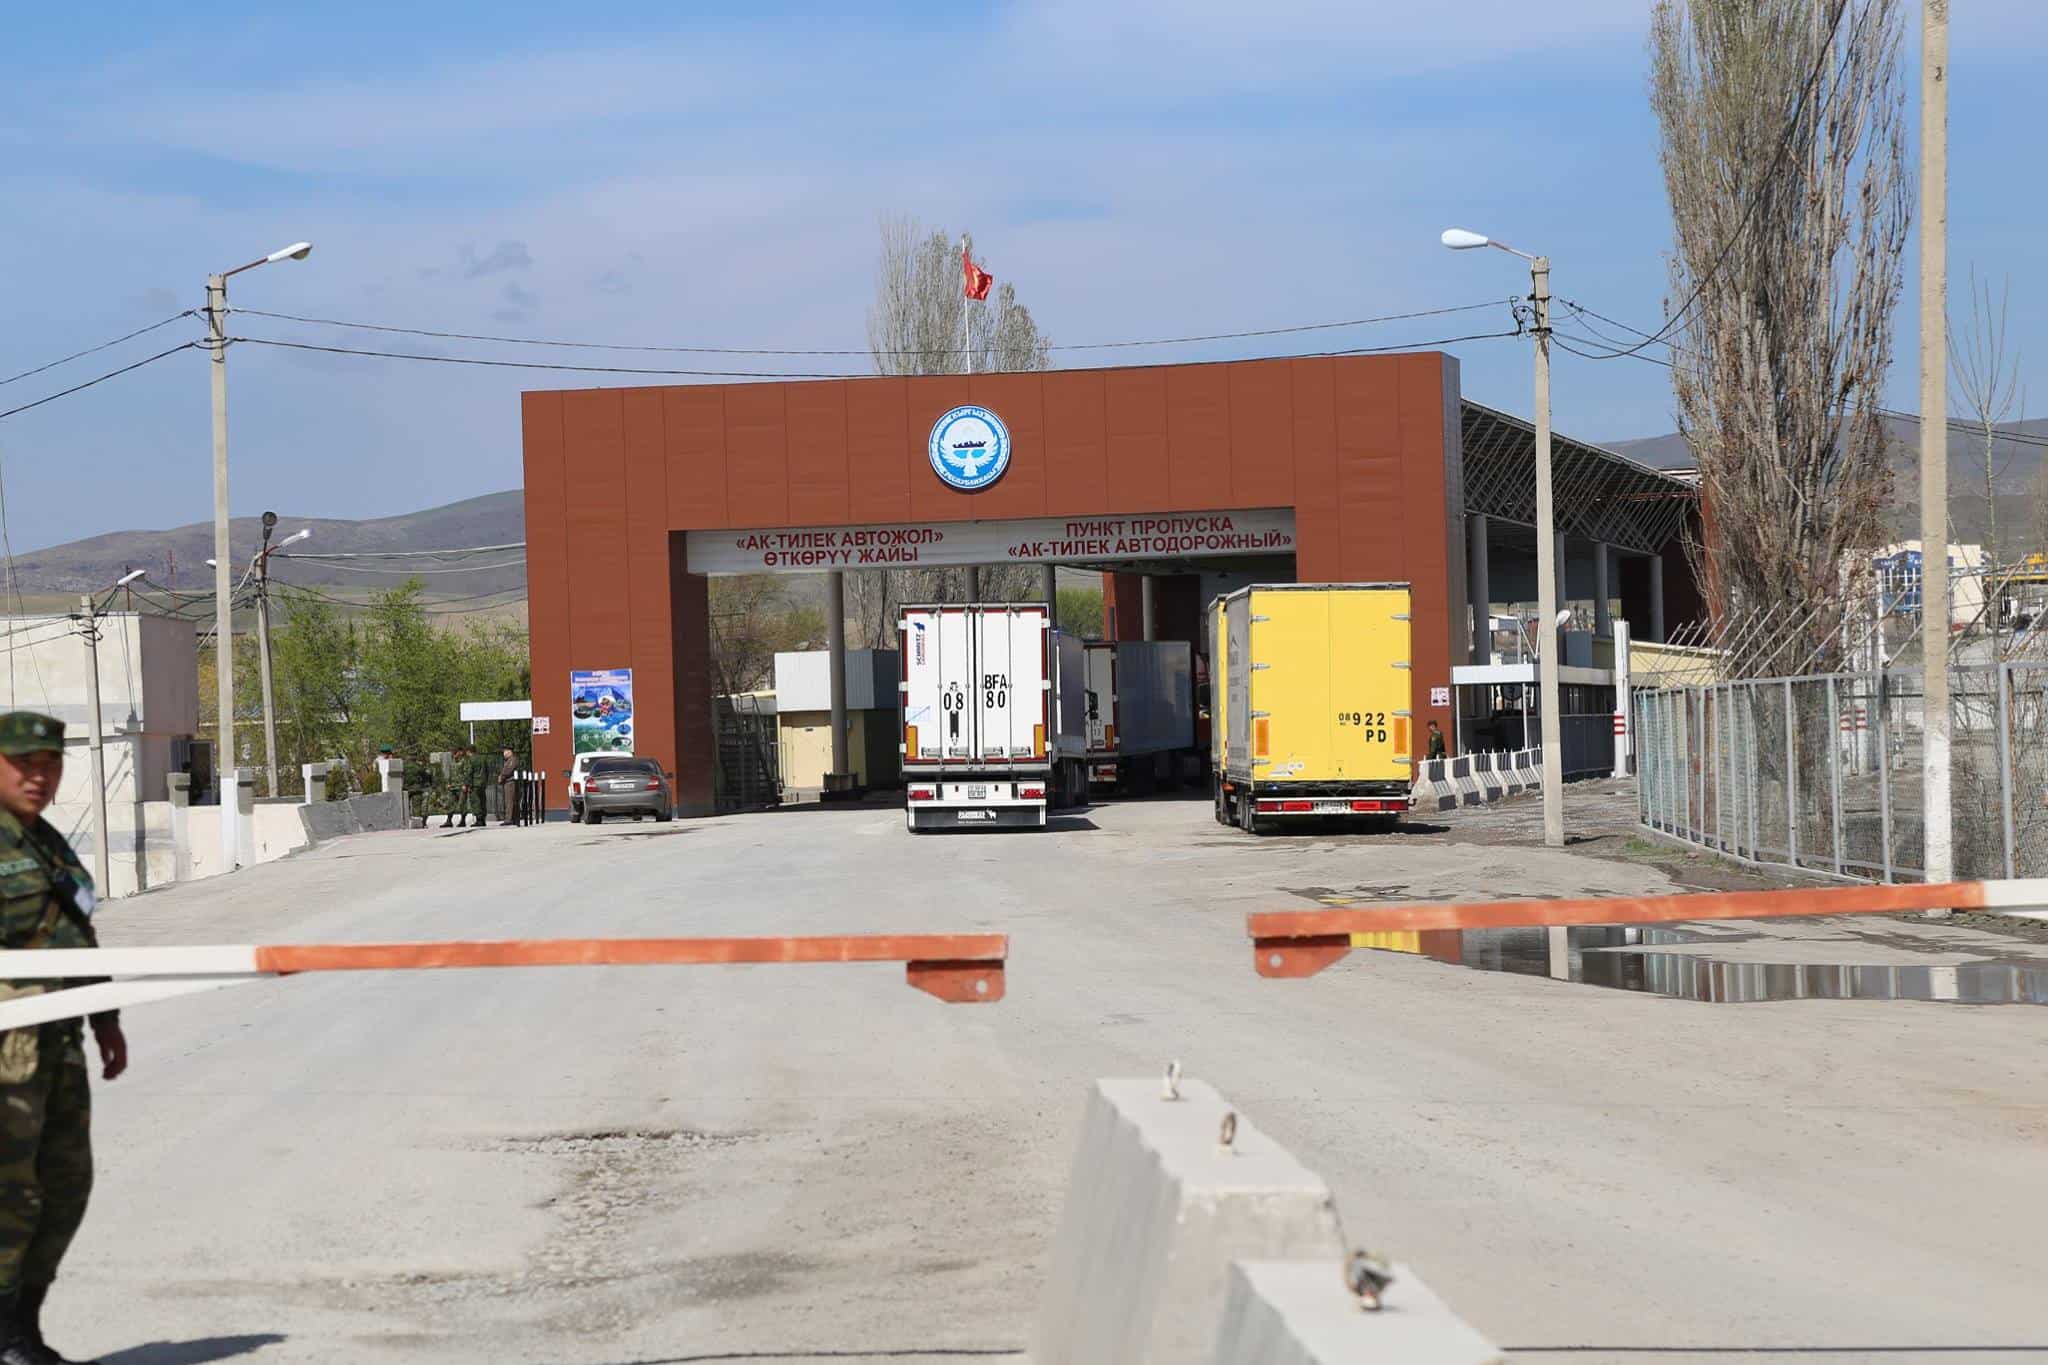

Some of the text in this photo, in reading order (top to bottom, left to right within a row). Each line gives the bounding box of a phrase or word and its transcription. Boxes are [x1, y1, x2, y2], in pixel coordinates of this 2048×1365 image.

[1065, 516, 1234, 538] ПУНКТ ПРОПУСКА
[735, 528, 944, 551] «АК-ТИЛЕК АВТОЖОЛ»
[1007, 529, 1292, 558] «АК-ТИЛЕК АВТОДОРОЖНЫЙ»
[763, 544, 919, 567] ӨТКӨРҮҮ ЖАЙЫ
[984, 674, 1008, 691] BFA
[943, 691, 1006, 711] 08 80
[1352, 712, 1386, 727] 922
[1365, 729, 1387, 743] PD
